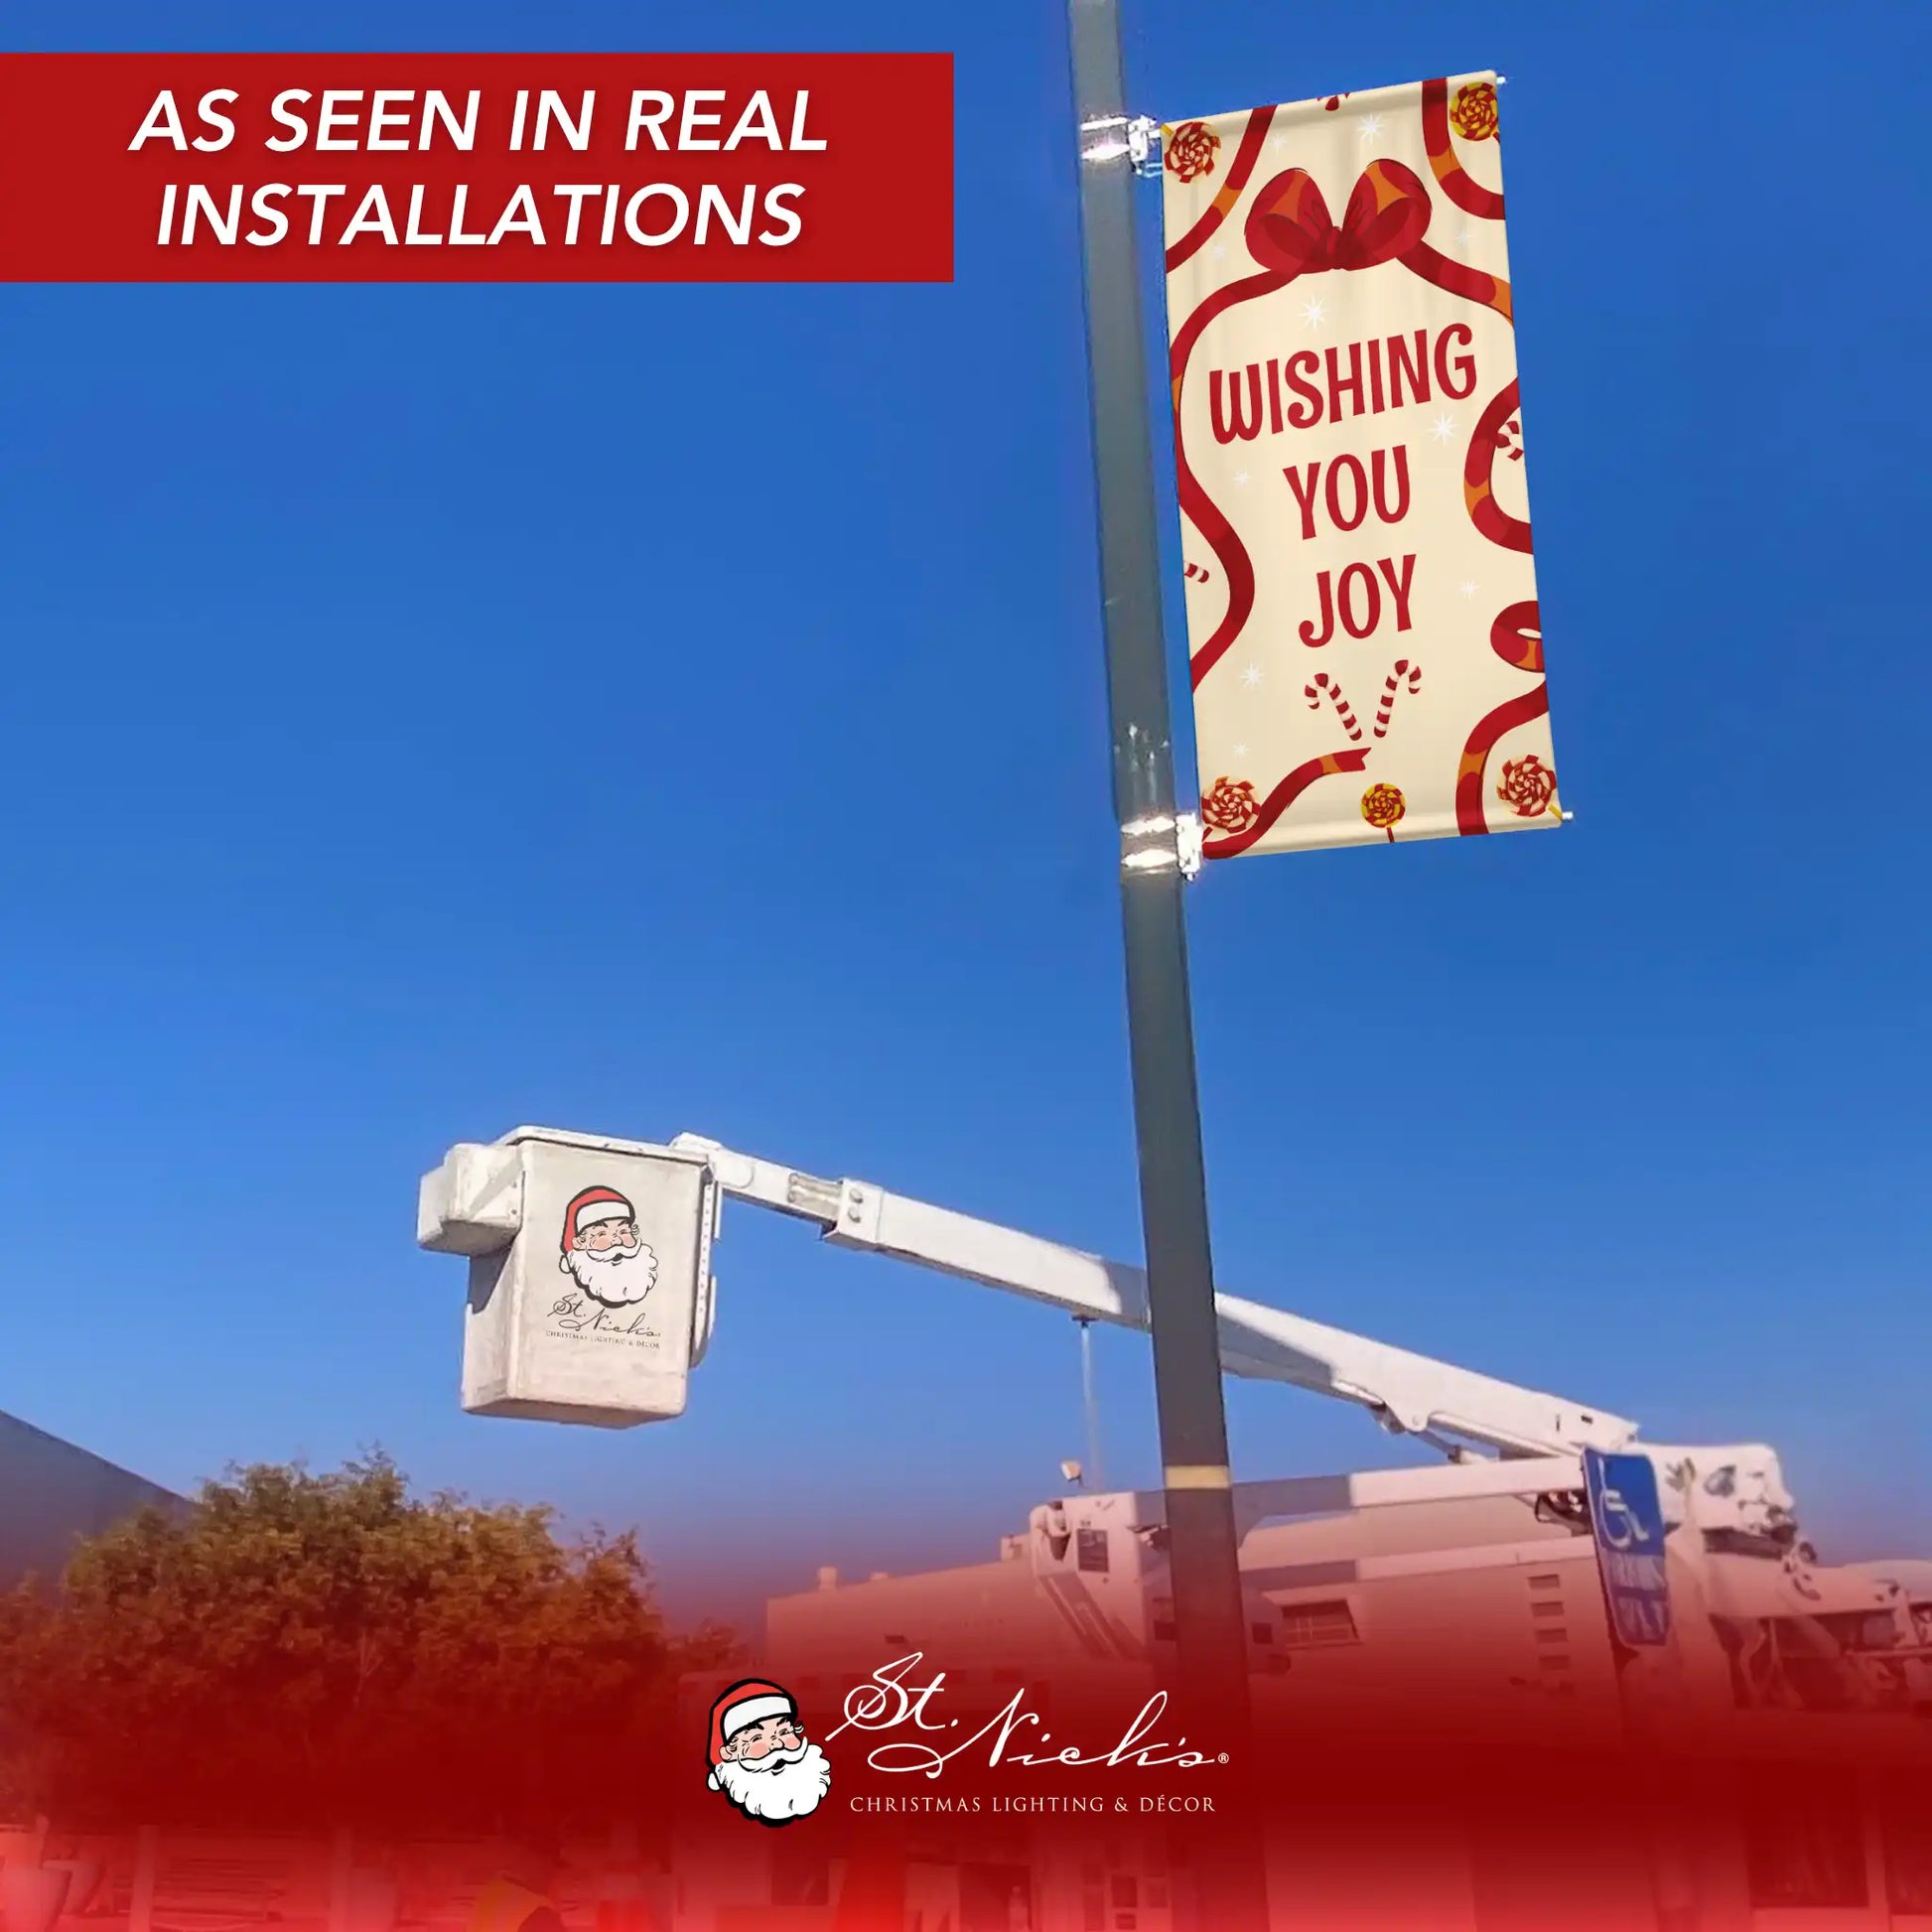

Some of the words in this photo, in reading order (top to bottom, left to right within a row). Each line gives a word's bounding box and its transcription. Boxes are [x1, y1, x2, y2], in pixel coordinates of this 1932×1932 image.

[1209, 323, 1477, 445] WISHING
[1282, 444, 1412, 540] YOU
[1298, 553, 1418, 648] JOY
[547, 1293, 587, 1318] St.
